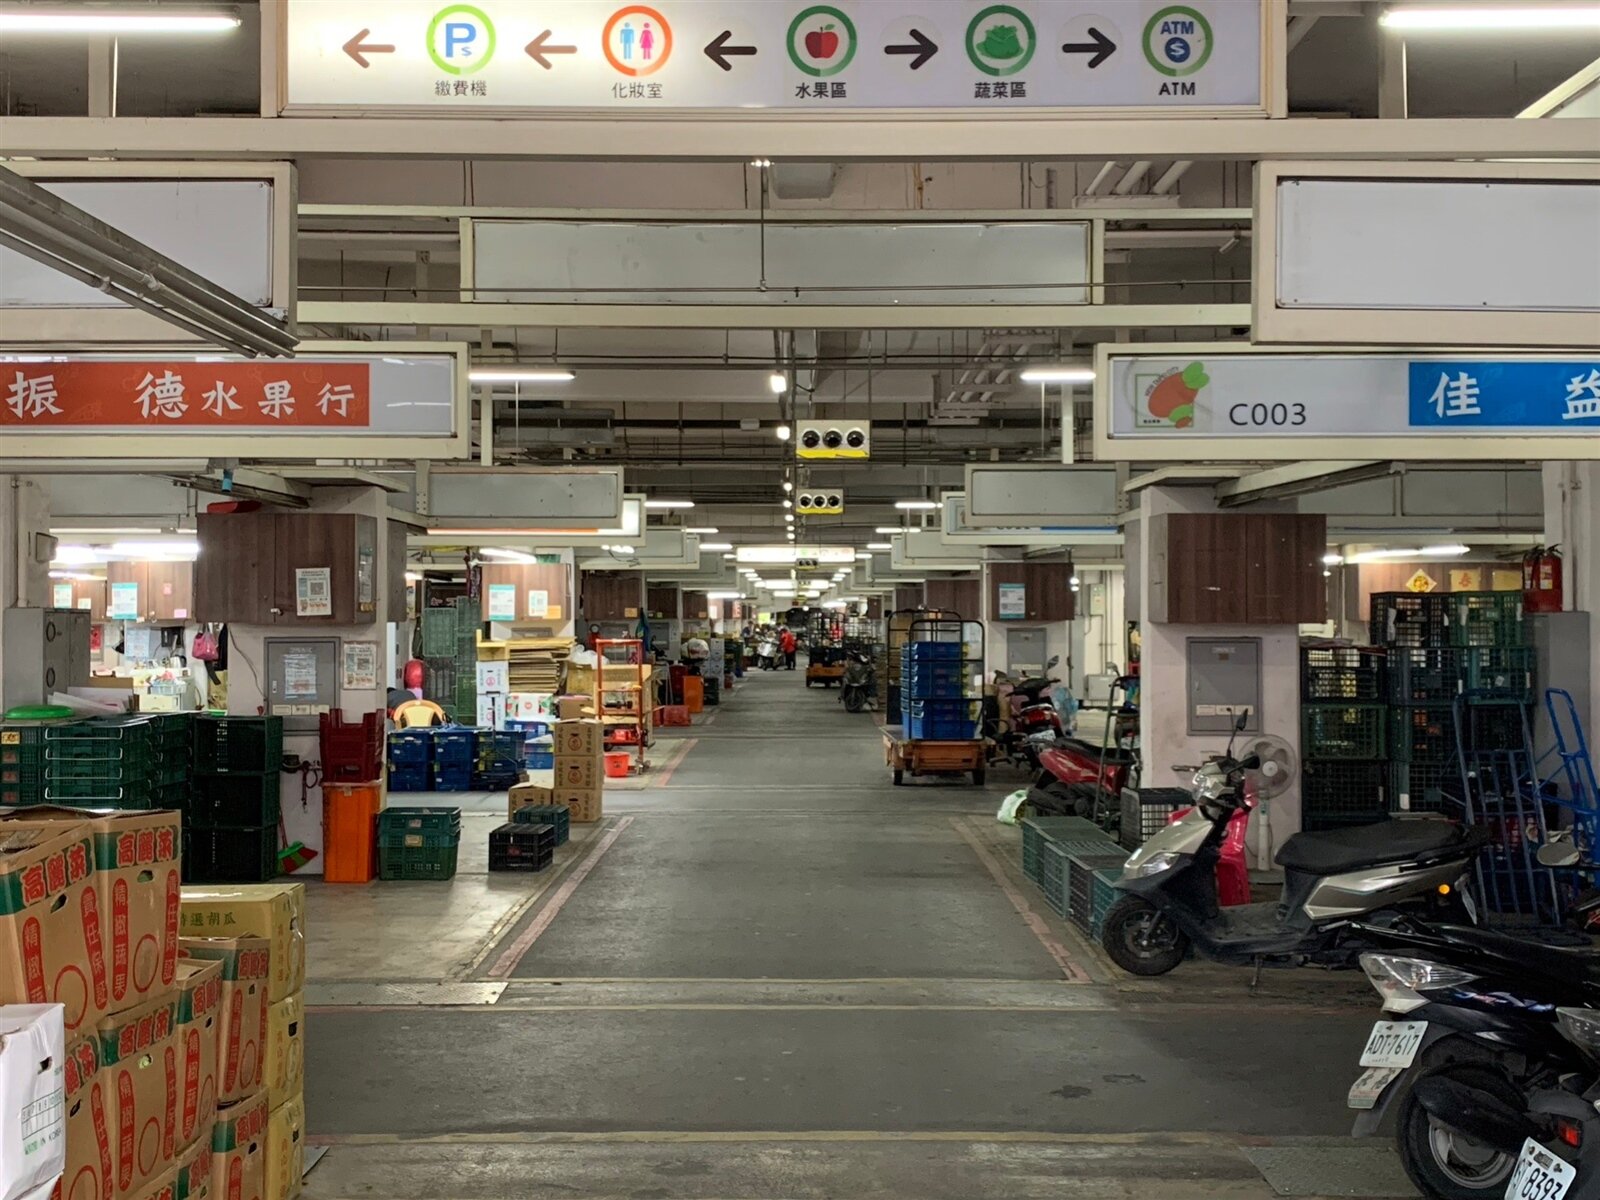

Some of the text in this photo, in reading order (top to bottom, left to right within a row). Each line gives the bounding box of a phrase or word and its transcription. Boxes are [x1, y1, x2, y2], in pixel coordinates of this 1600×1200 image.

[1160, 21, 1194, 35] ATM
[435, 80, 487, 96] 繳費機
[612, 82, 663, 99] 化妝室
[795, 82, 847, 99] 水果區
[974, 82, 1027, 99] 蔬菜區
[1159, 82, 1196, 96] ATM
[1229, 403, 1306, 426] C003
[119, 828, 174, 866] 高麗菜
[22, 844, 87, 904] 高麗菜
